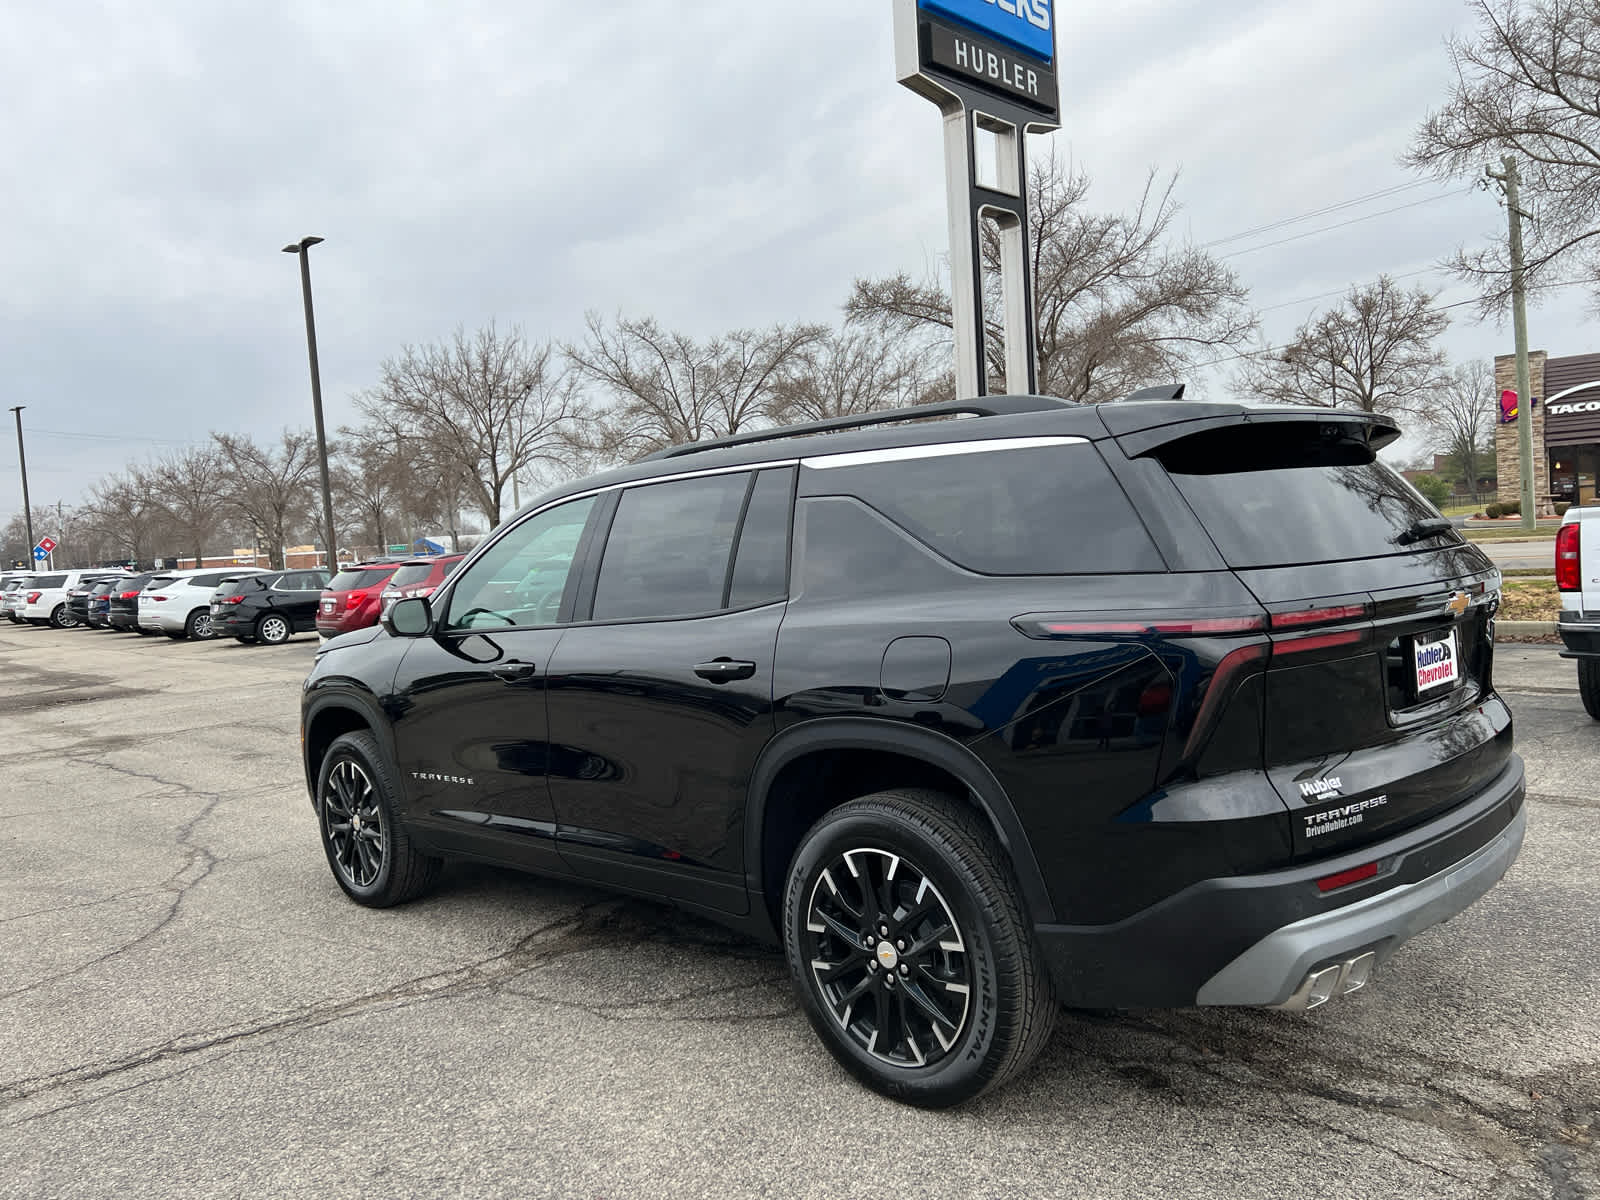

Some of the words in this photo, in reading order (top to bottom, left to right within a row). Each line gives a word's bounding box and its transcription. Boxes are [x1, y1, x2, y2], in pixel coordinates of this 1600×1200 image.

[954, 39, 1038, 97] HUBLER
[1547, 401, 1600, 415] TACO
[1416, 646, 1442, 669] Hubler
[1418, 661, 1454, 687] Chevrolet
[411, 772, 474, 785] TRAVERSE
[1299, 777, 1342, 796] Hubler
[1303, 794, 1388, 825] TRAVERSE
[1305, 813, 1363, 838] DriveHubler.com
